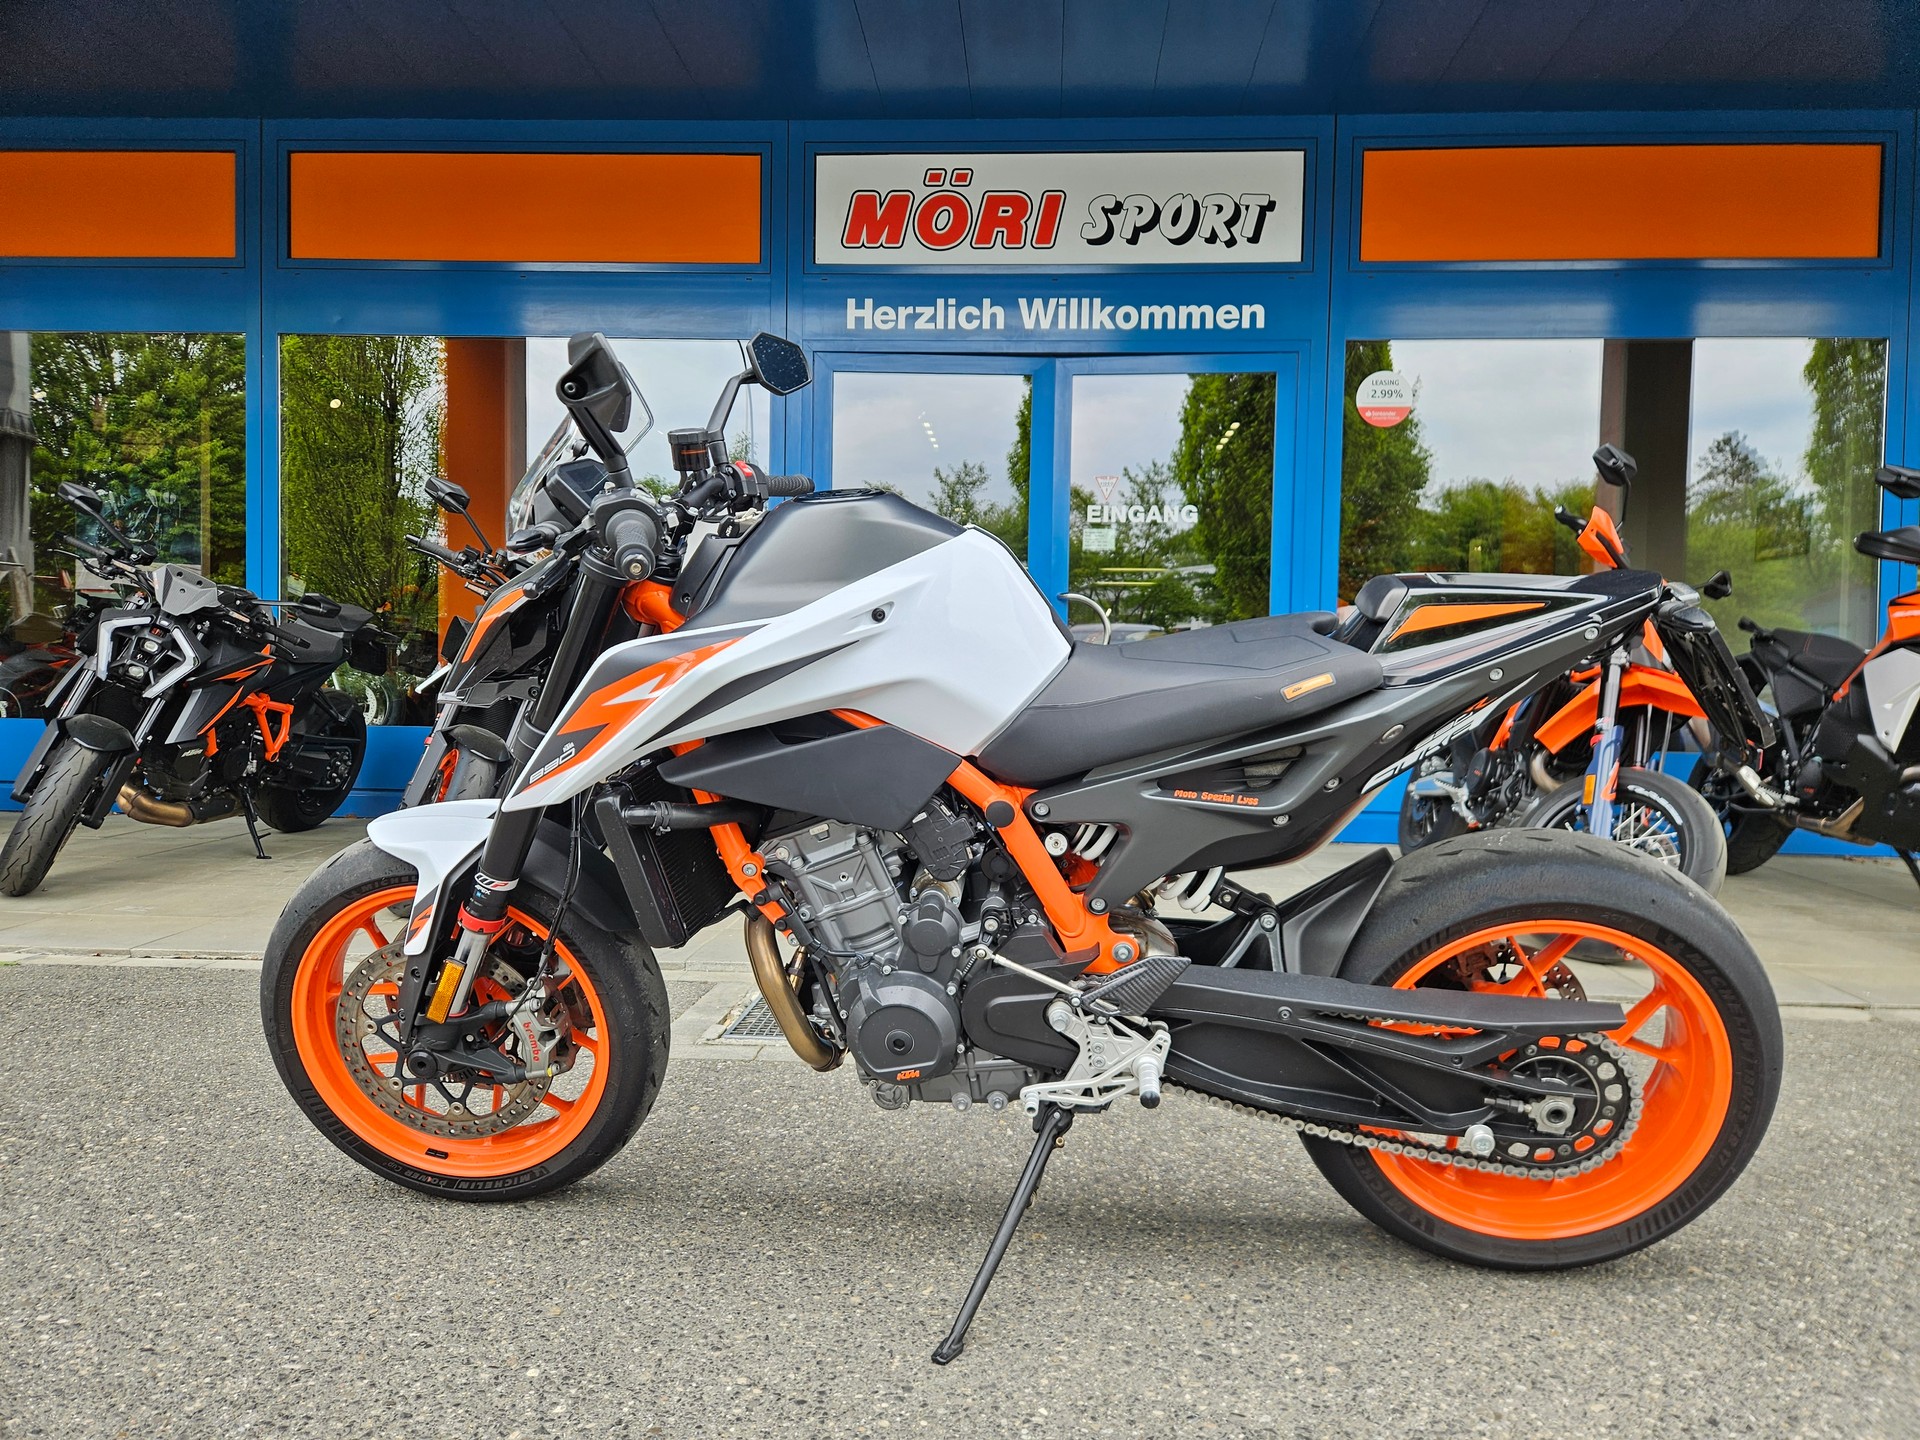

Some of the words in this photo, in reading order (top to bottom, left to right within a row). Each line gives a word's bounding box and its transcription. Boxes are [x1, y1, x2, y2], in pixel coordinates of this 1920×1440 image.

[841, 168, 1067, 251] MÖRI
[1080, 193, 1277, 249] SPORT
[846, 297, 1005, 330] Herzlich
[1018, 297, 1266, 330] Willkommen
[1371, 389, 1404, 399] 2.99%
[1086, 504, 1199, 524] EINGANG
[529, 747, 576, 785] 890
[1174, 790, 1198, 799] Moto
[1201, 791, 1234, 803] Spezial
[1237, 795, 1259, 806] Lyss
[523, 1021, 541, 1062] brembo
[896, 1069, 920, 1081] KTM
[404, 1168, 448, 1186] POWER
[458, 1172, 531, 1190] MICHELIN
